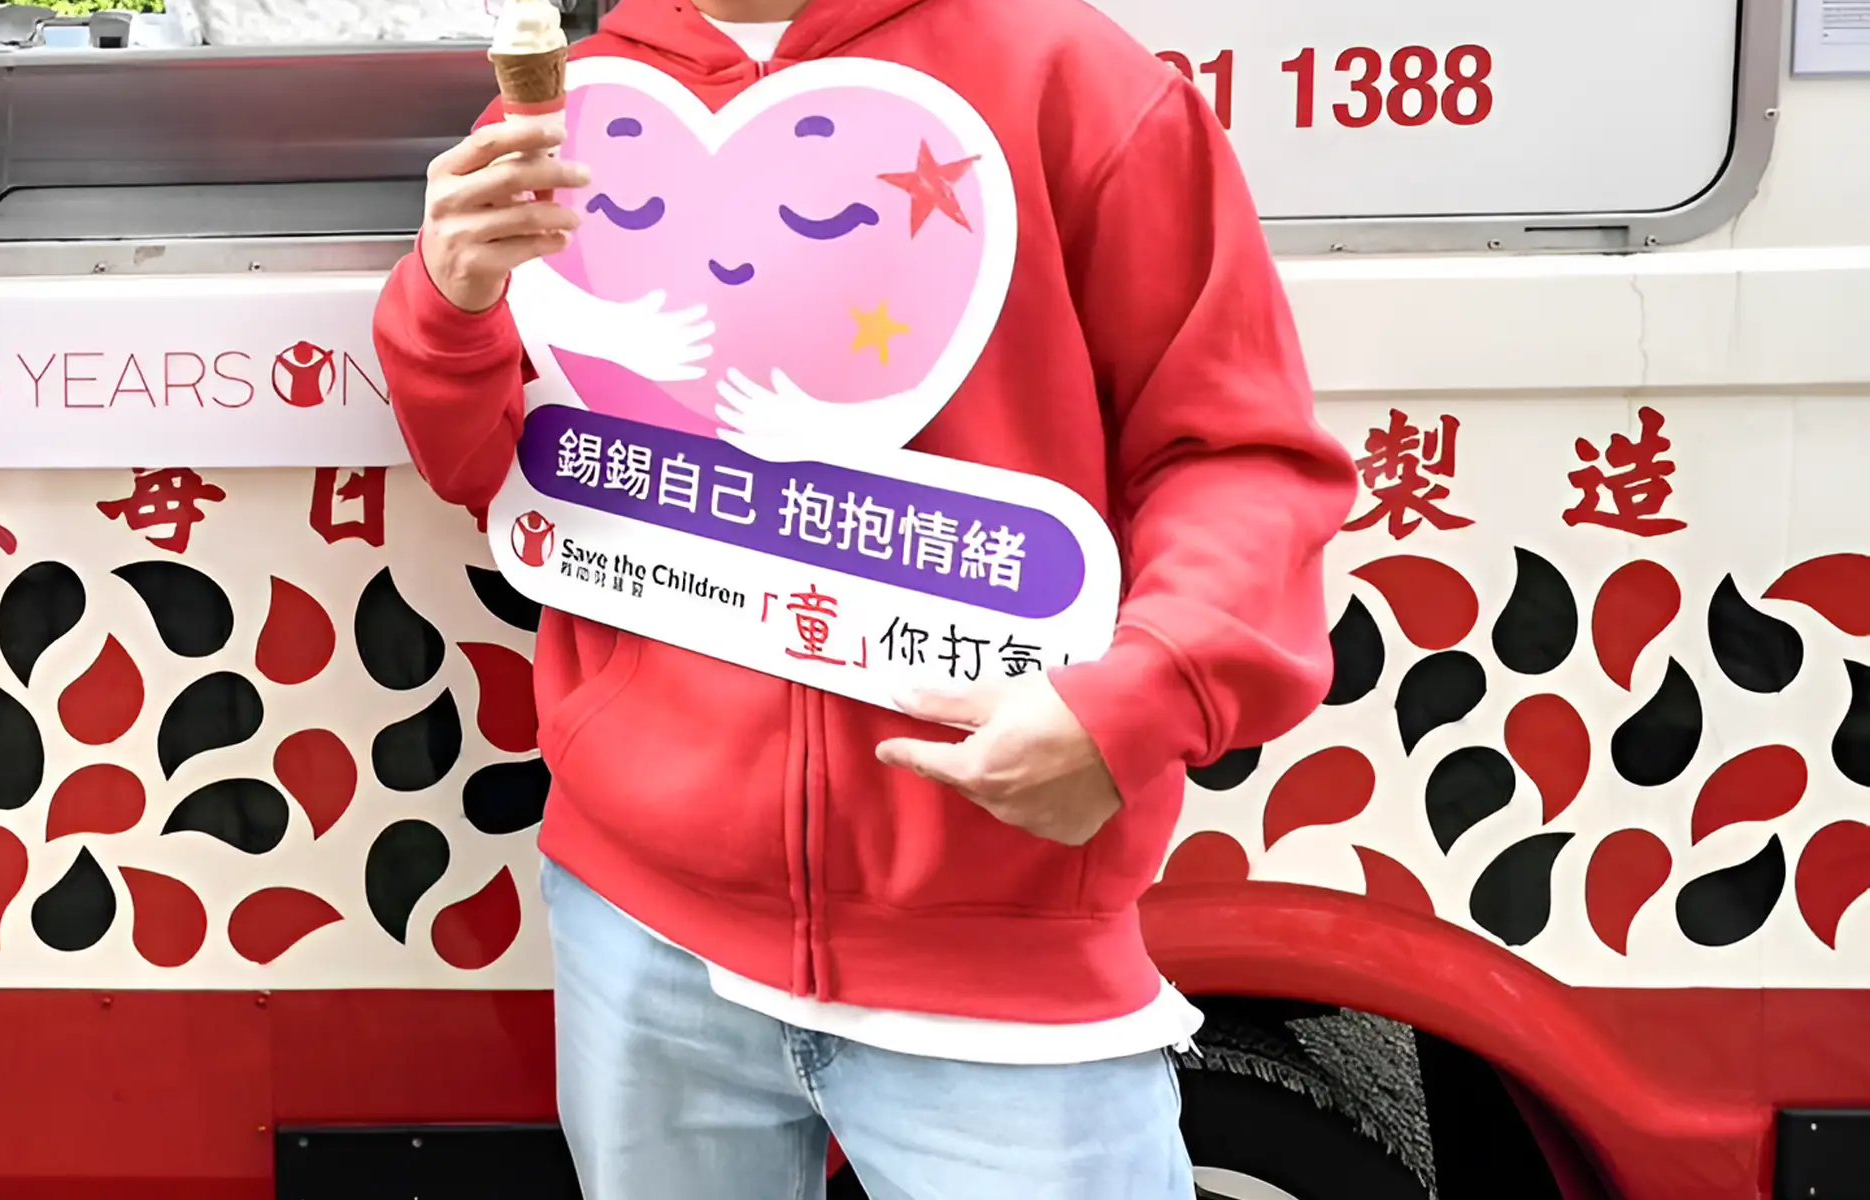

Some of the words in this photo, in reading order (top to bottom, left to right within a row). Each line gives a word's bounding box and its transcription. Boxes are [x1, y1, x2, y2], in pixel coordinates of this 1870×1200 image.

[1281, 45, 1493, 128] 1388
[18, 350, 256, 410] YEARS
[555, 427, 757, 526] 錫錫自己
[778, 478, 1026, 593] 抱抱情緒
[561, 538, 608, 570] Save
[613, 554, 647, 580] the
[651, 564, 745, 608] Children
